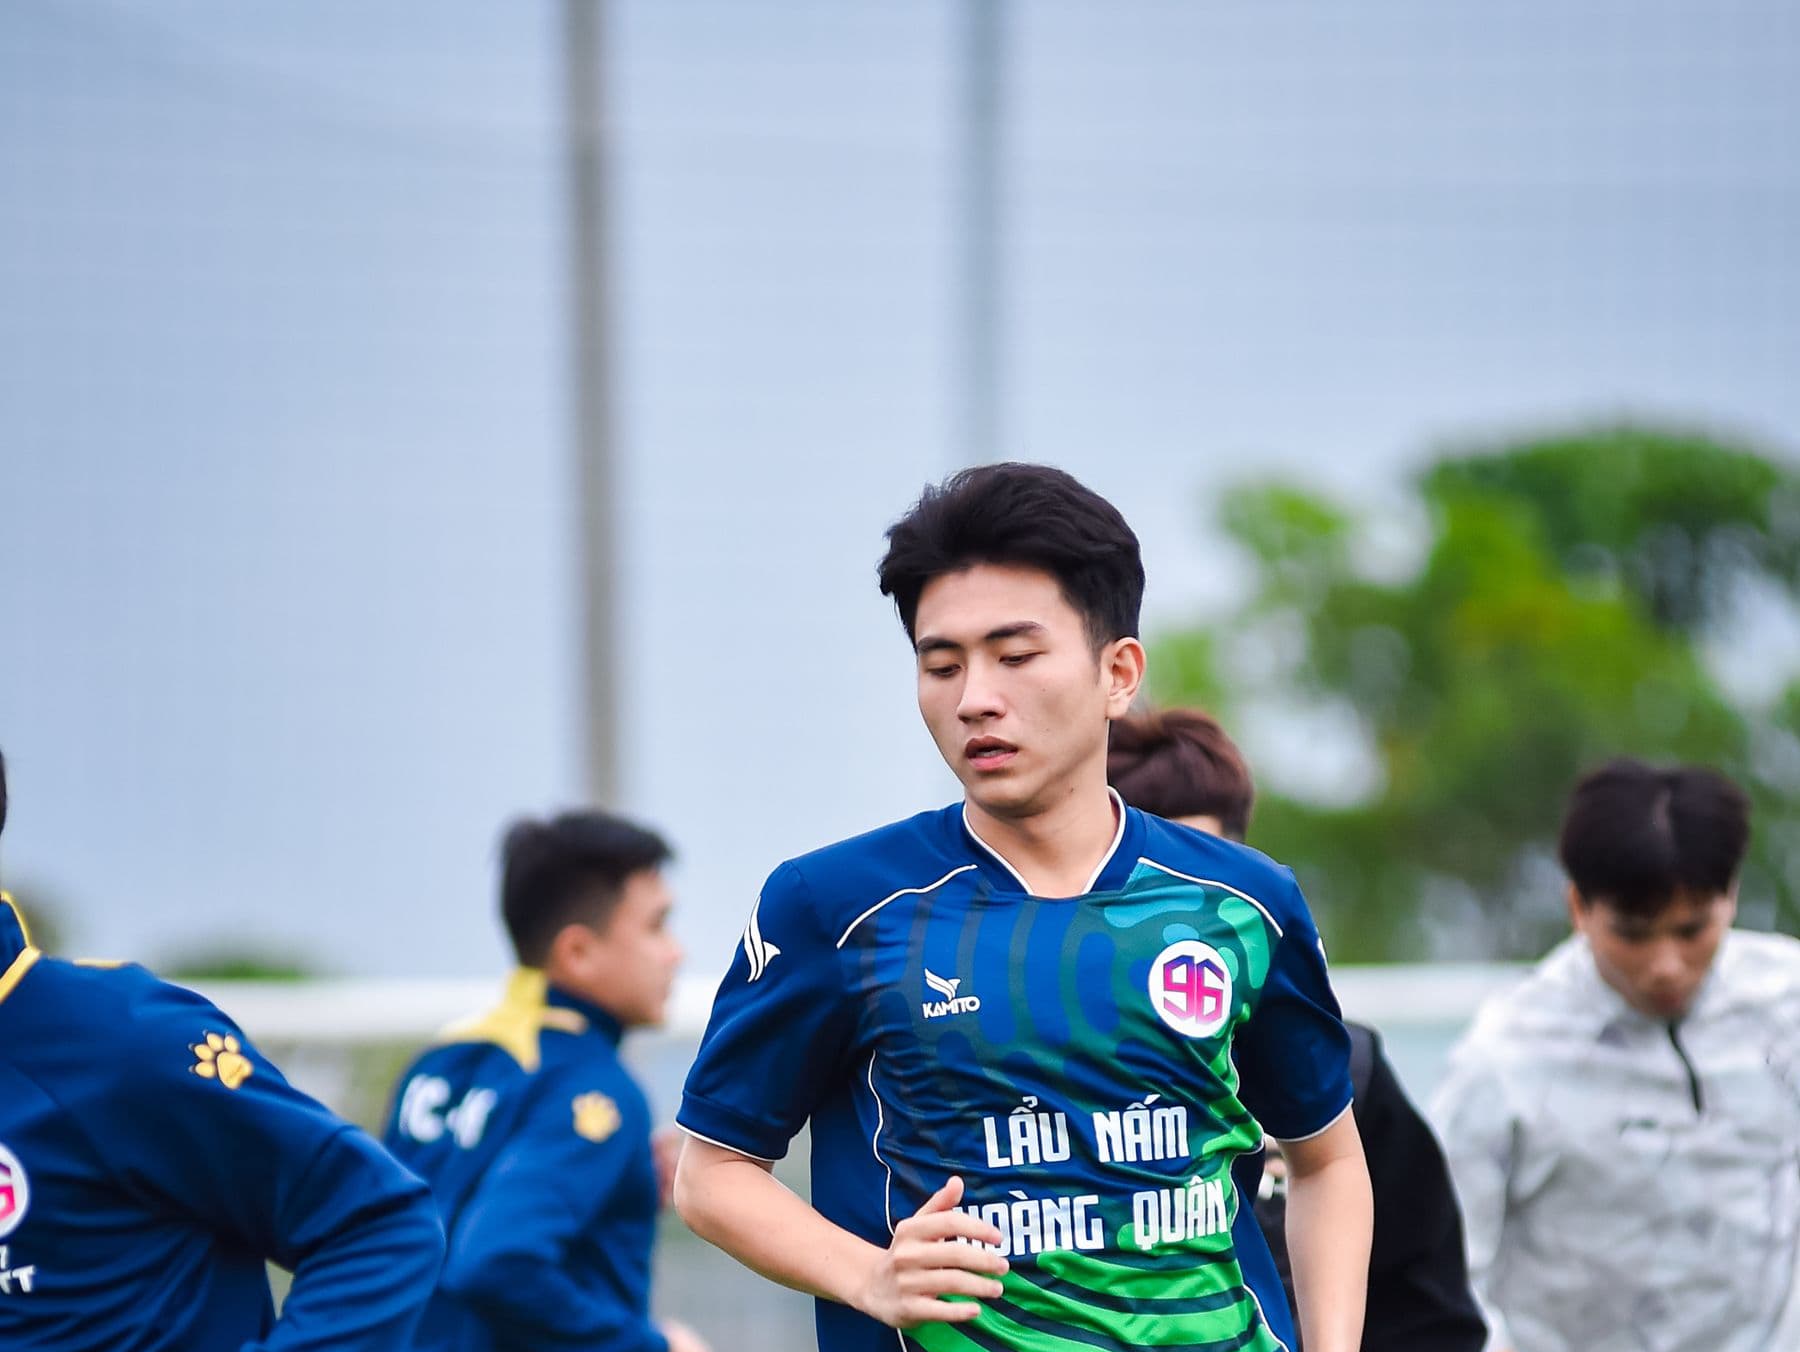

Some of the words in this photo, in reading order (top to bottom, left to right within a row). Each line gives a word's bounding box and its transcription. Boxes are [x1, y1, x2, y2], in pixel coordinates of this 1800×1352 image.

[922, 996, 981, 1019] KAMITO
[1162, 954, 1226, 1024] 96
[983, 1095, 1071, 1169] LẨU
[1092, 1093, 1190, 1163] NẤM
[1133, 1175, 1228, 1251] QUÂN
